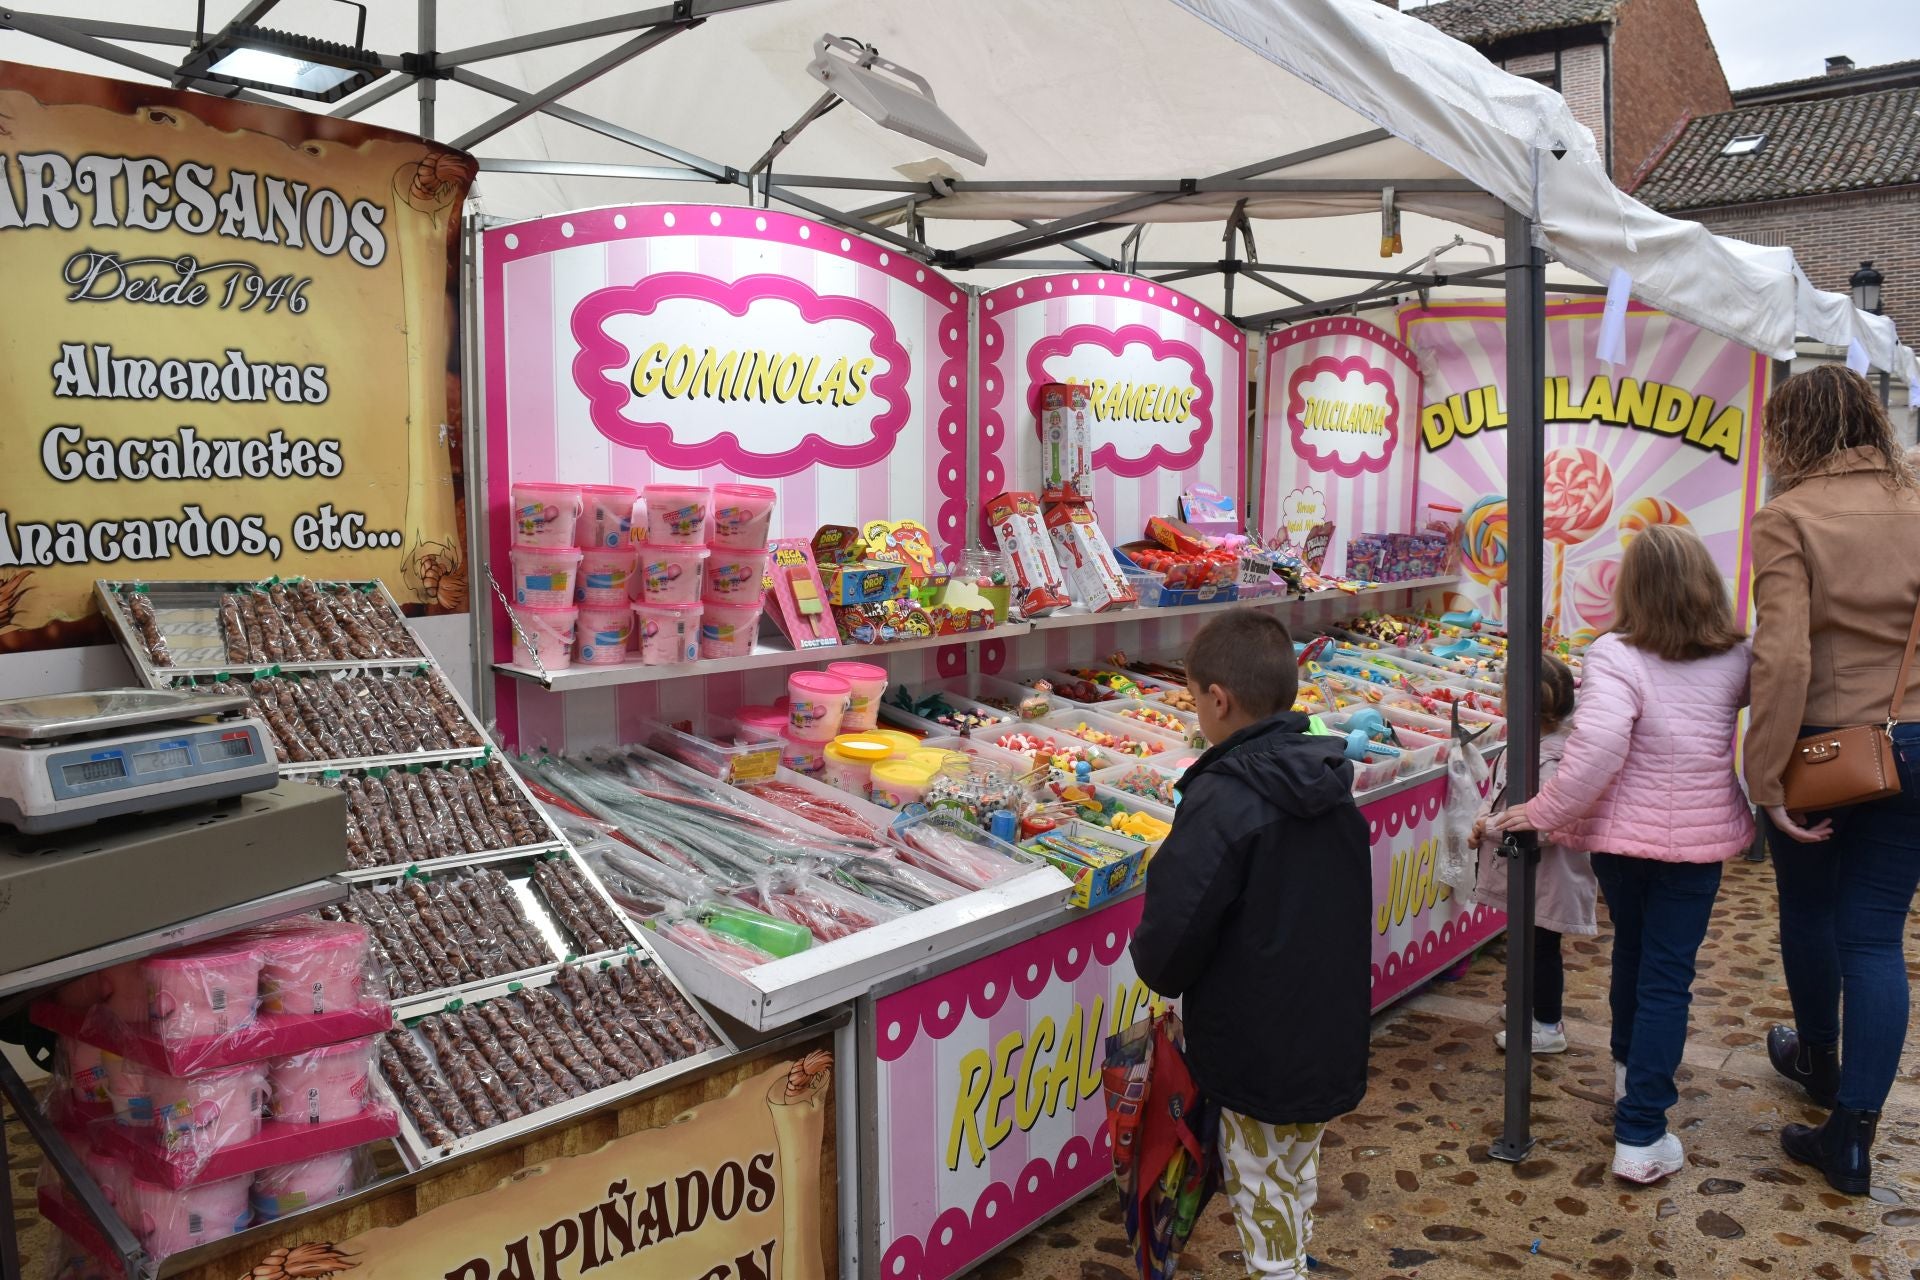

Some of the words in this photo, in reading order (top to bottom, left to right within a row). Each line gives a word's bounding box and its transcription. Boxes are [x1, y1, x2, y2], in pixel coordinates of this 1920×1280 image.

[63, 250, 212, 306] Desde
[220, 271, 312, 314] 1946
[53, 343, 329, 403] Almendras
[630, 342, 875, 407] GOMINOLAS
[1064, 375, 1196, 424] RAMELOS
[1303, 395, 1386, 437] DULCILANDIA
[1421, 374, 1746, 466] DULILANDIA
[42, 426, 344, 480] Cacahuetes
[293, 504, 402, 551] etc...
[776, 549, 803, 560] MEGA
[863, 576, 885, 589] DROP
